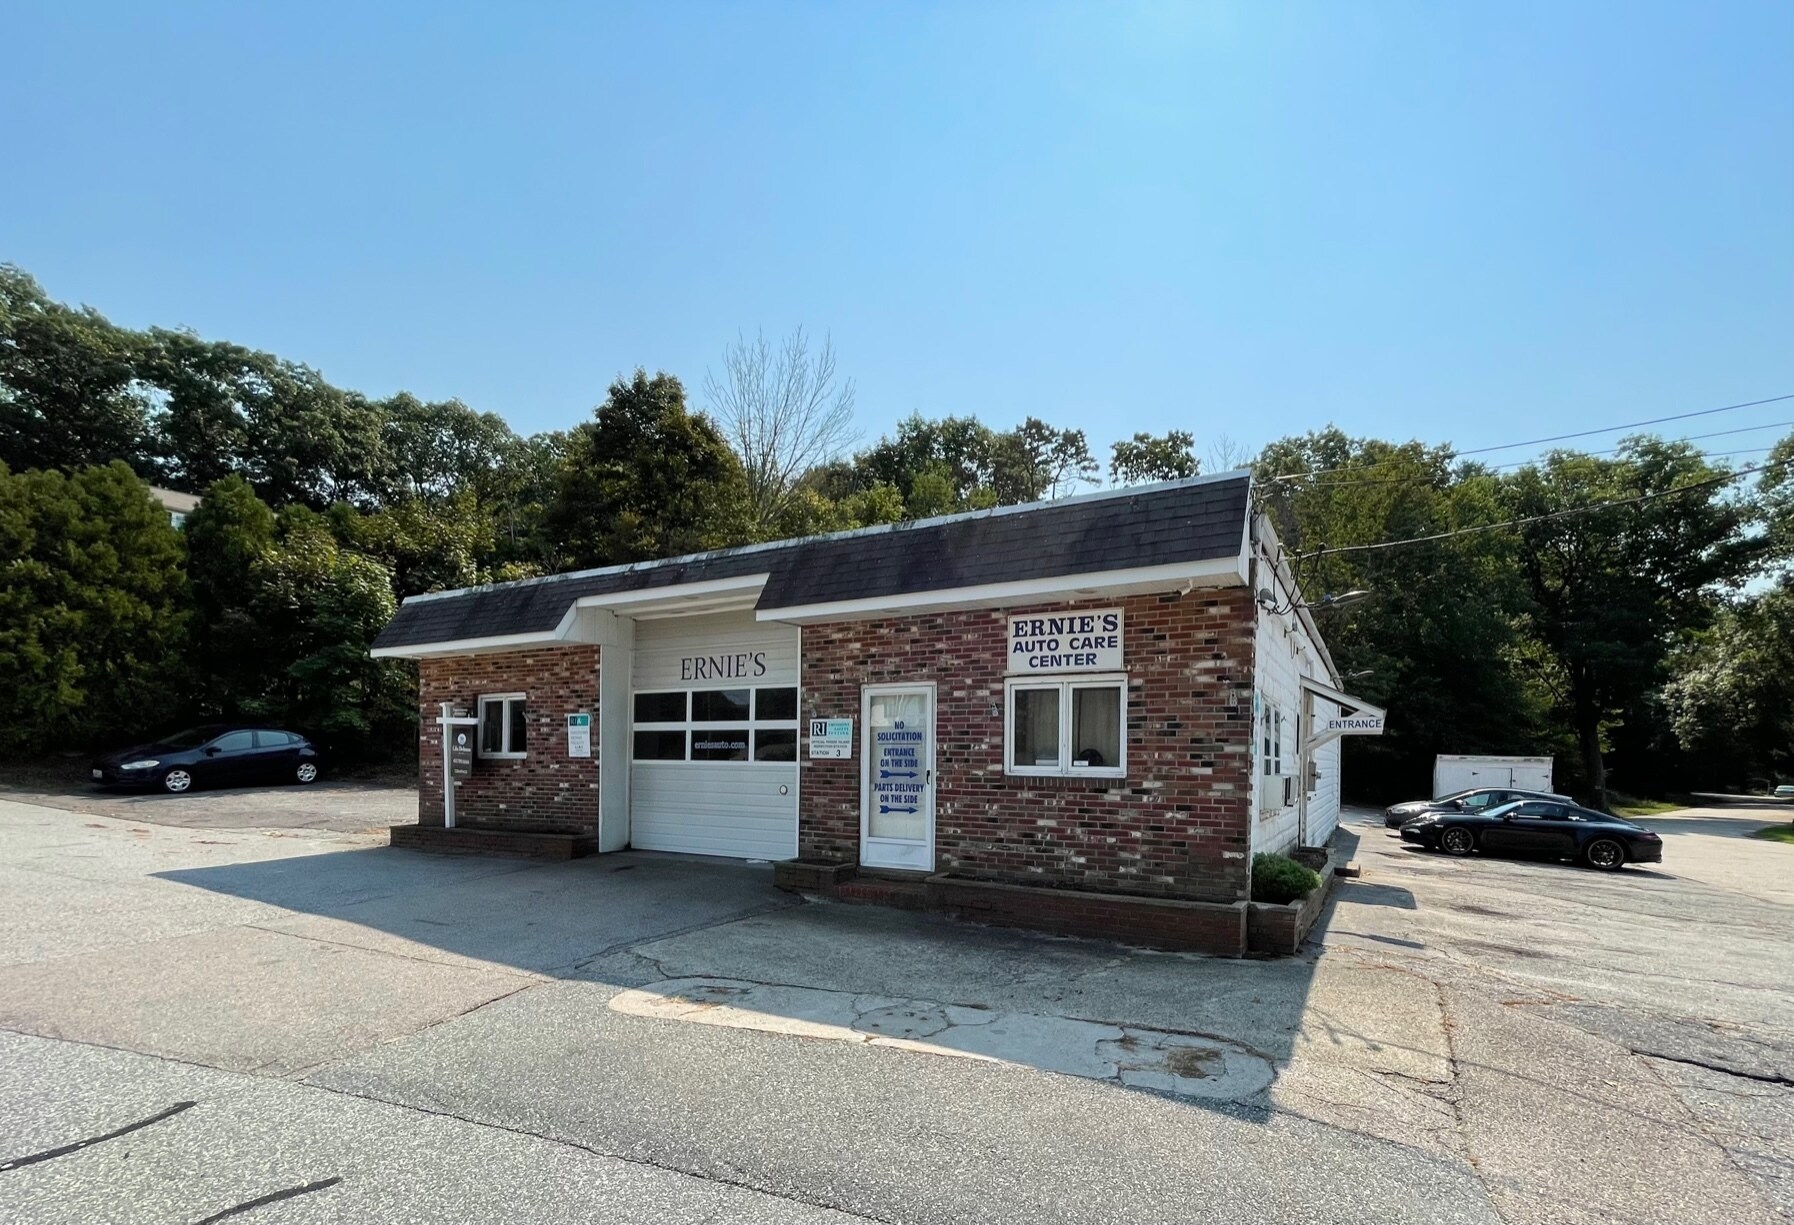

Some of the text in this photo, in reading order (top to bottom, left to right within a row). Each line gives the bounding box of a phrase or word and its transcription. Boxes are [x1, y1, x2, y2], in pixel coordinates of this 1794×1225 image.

[1013, 614, 1118, 638] ERNIE'S
[1013, 636, 1118, 653] AUTO CARE
[1029, 653, 1097, 668] CENTER
[681, 652, 766, 680] ERNIE'S
[813, 722, 825, 735] RI
[894, 721, 905, 730] NO
[1329, 719, 1382, 729] ENTRANCE
[877, 731, 922, 741] SOLICITATION
[836, 749, 841, 757] 3
[883, 748, 915, 757] ENTRANCE
[880, 758, 918, 768] ON THE SIDE
[874, 783, 924, 792] PARTS DELIVERY
[880, 794, 918, 803] ON THE SIDE
